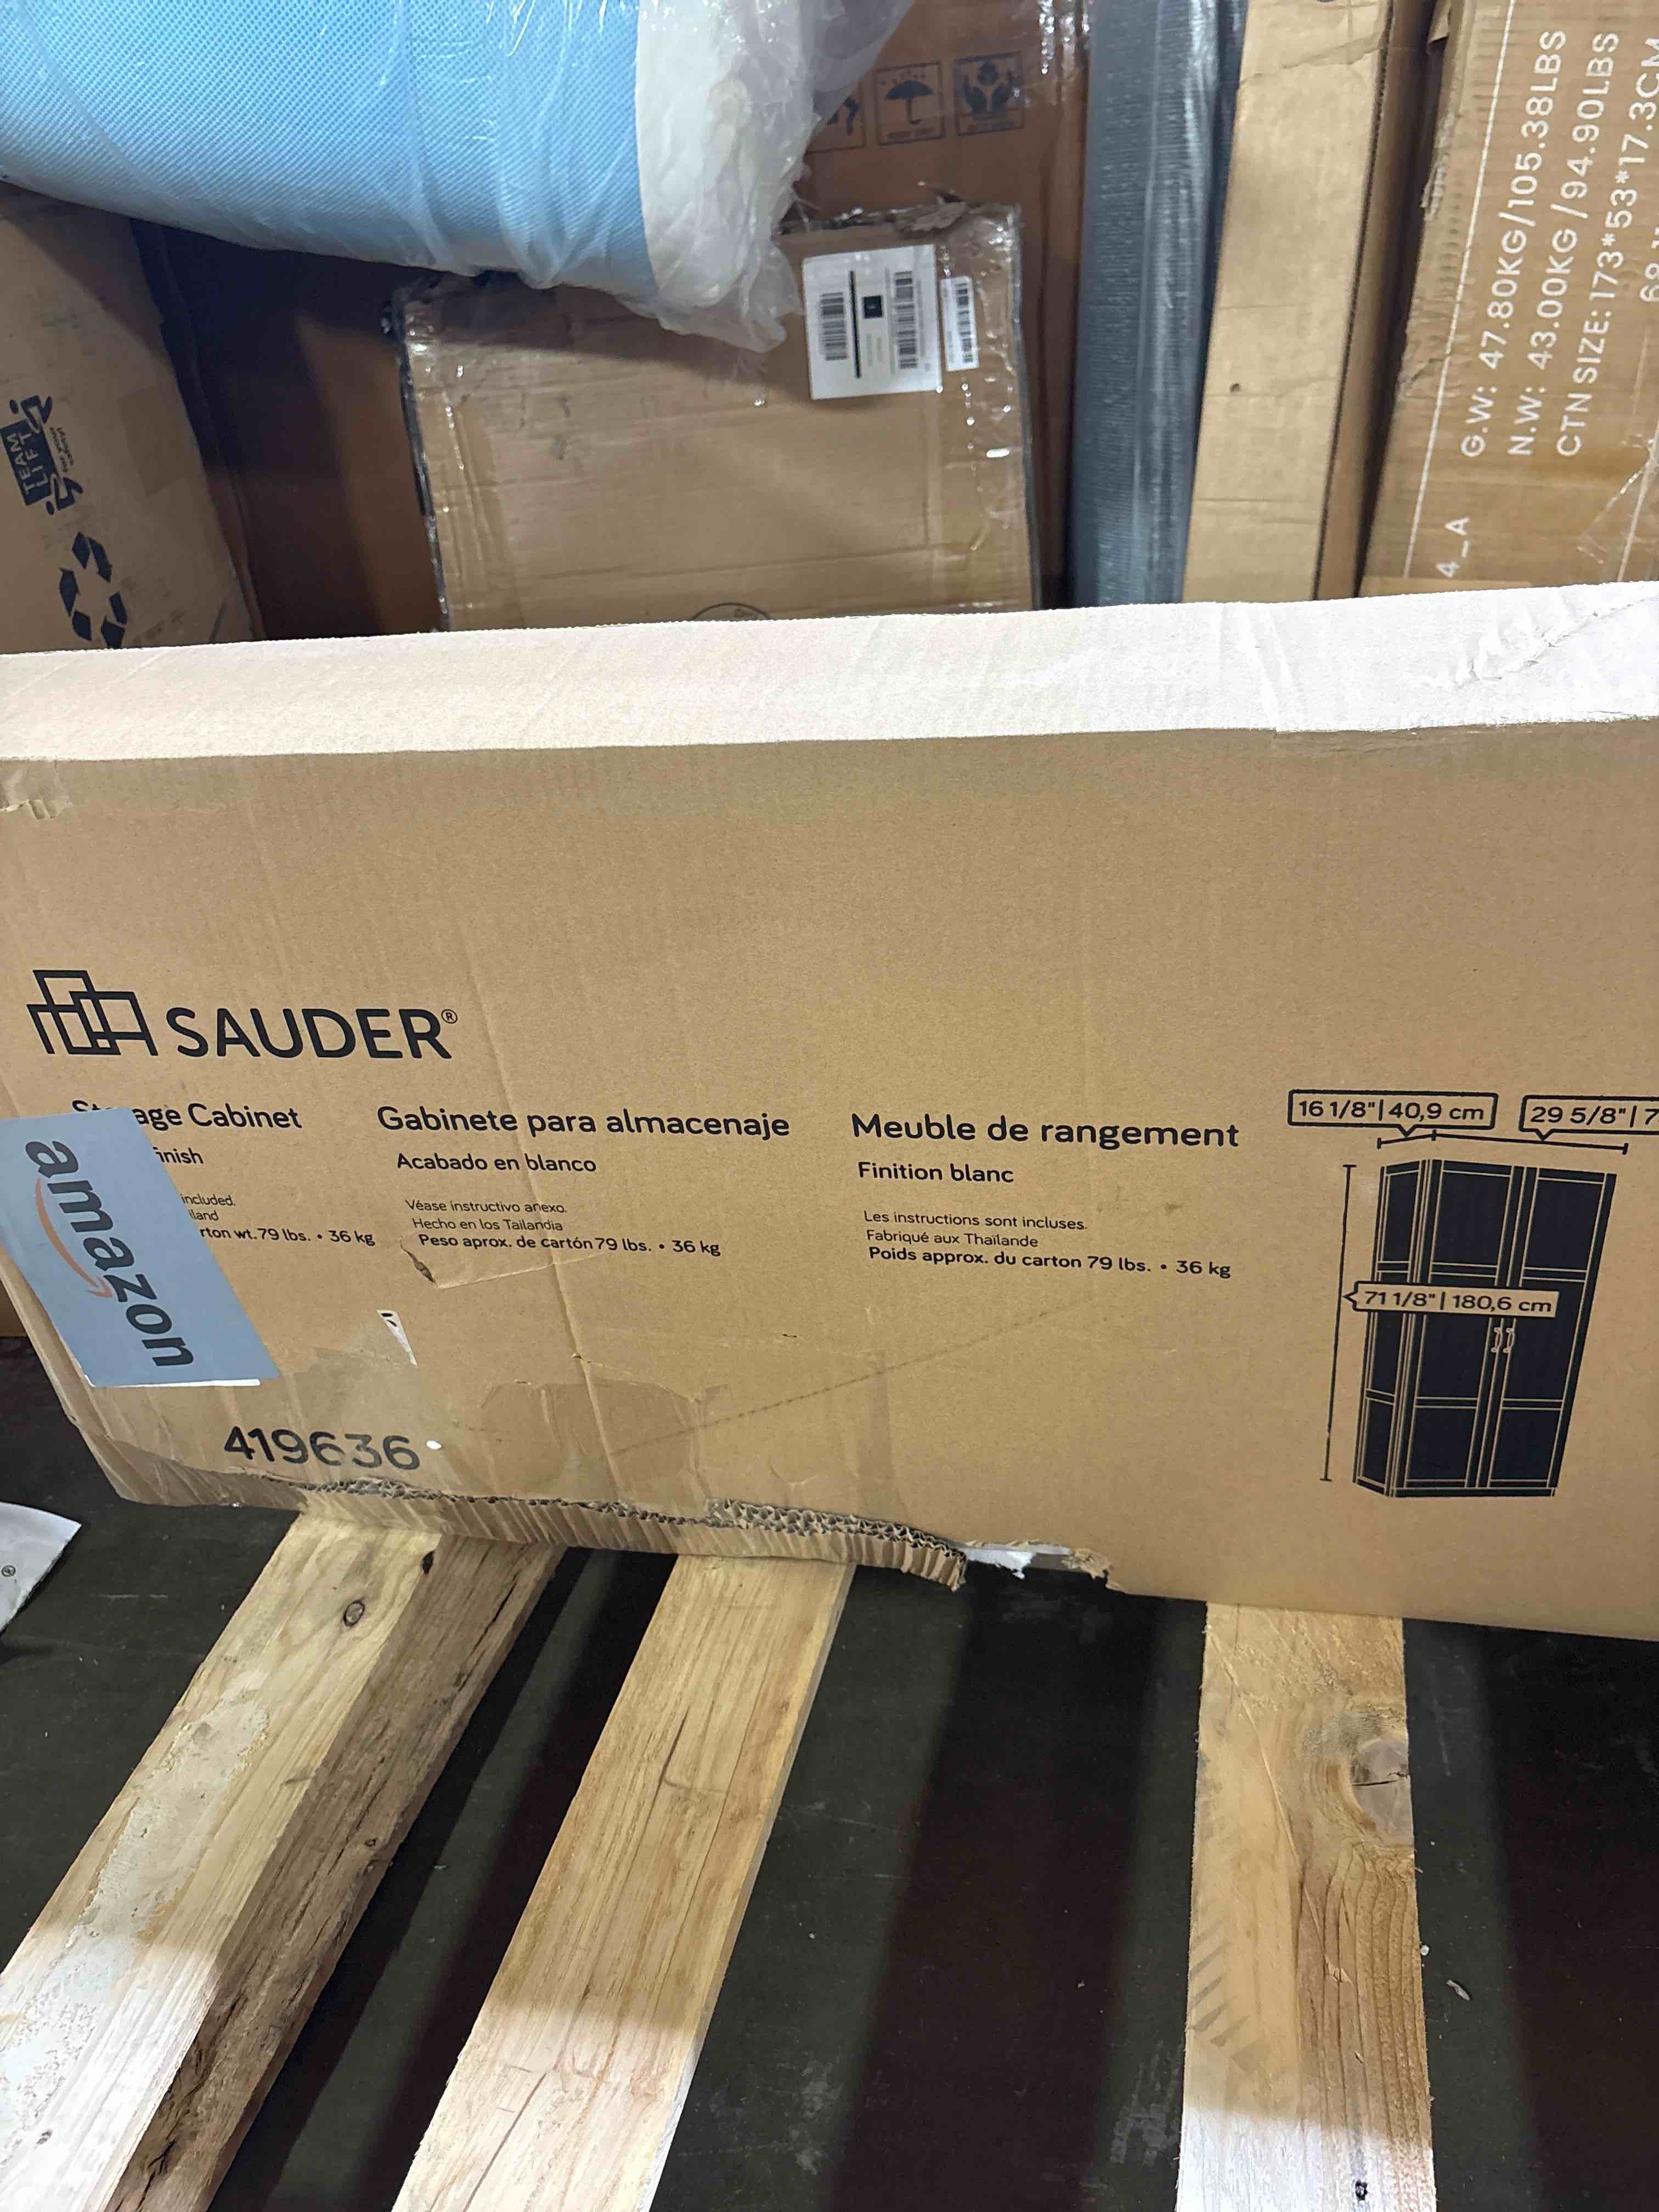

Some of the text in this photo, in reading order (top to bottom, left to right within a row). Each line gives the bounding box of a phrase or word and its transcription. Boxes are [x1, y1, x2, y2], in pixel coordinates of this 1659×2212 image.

[1461, 31, 1566, 457] G.W: 47.80KG/105.38LBS
[1508, 386, 1546, 456] N.W:
[1556, 393, 1593, 457] CTN
[6, 432, 35, 495] TEAM
[18, 432, 49, 487] LIFT
[187, 1102, 303, 1128] Cabinet
[1299, 1100, 1324, 1117] 16
[1388, 1102, 1442, 1122] 40,9
[1448, 1107, 1485, 1120] cm
[1530, 1106, 1564, 1123] 29
[377, 1105, 790, 1141] Gabinete para almacenaje
[851, 1113, 1240, 1150] Meuble de rangement
[153, 1146, 205, 1165] inish
[396, 1153, 597, 1173] Acabado en blanco
[858, 1161, 1014, 1183] Finition blanc
[188, 1209, 219, 1222] iland
[405, 1199, 567, 1214] Véase instructivo anexo.
[413, 1217, 563, 1232] Hecho en los Tailandia
[864, 1210, 1088, 1230] Les instructions sont incluses.
[199, 1227, 232, 1239] rton
[282, 1227, 312, 1242] lbs.
[328, 1229, 352, 1243] 36
[354, 1231, 375, 1247] kg
[419, 1234, 459, 1247] Peso
[462, 1237, 513, 1251] aprox.
[516, 1235, 537, 1249] de
[622, 1238, 652, 1252] lbs.
[672, 1240, 696, 1253] 36
[699, 1240, 721, 1257] kg
[866, 1229, 1039, 1248] Fabriqué aux Thaïlande
[25, 1140, 194, 1367] amazon
[868, 1246, 917, 1261] Poids
[922, 1251, 989, 1265] approx.
[994, 1251, 1017, 1266] du
[1022, 1254, 1082, 1268] carton
[1087, 1255, 1113, 1271] 79
[1118, 1257, 1152, 1272] lbs.
[1176, 1260, 1203, 1274] 36
[1208, 1261, 1232, 1279] kg
[1364, 1291, 1386, 1305] 71
[1452, 1294, 1512, 1312] 180,6
[1518, 1301, 1552, 1312] cm
[224, 1426, 420, 1470] 419636
